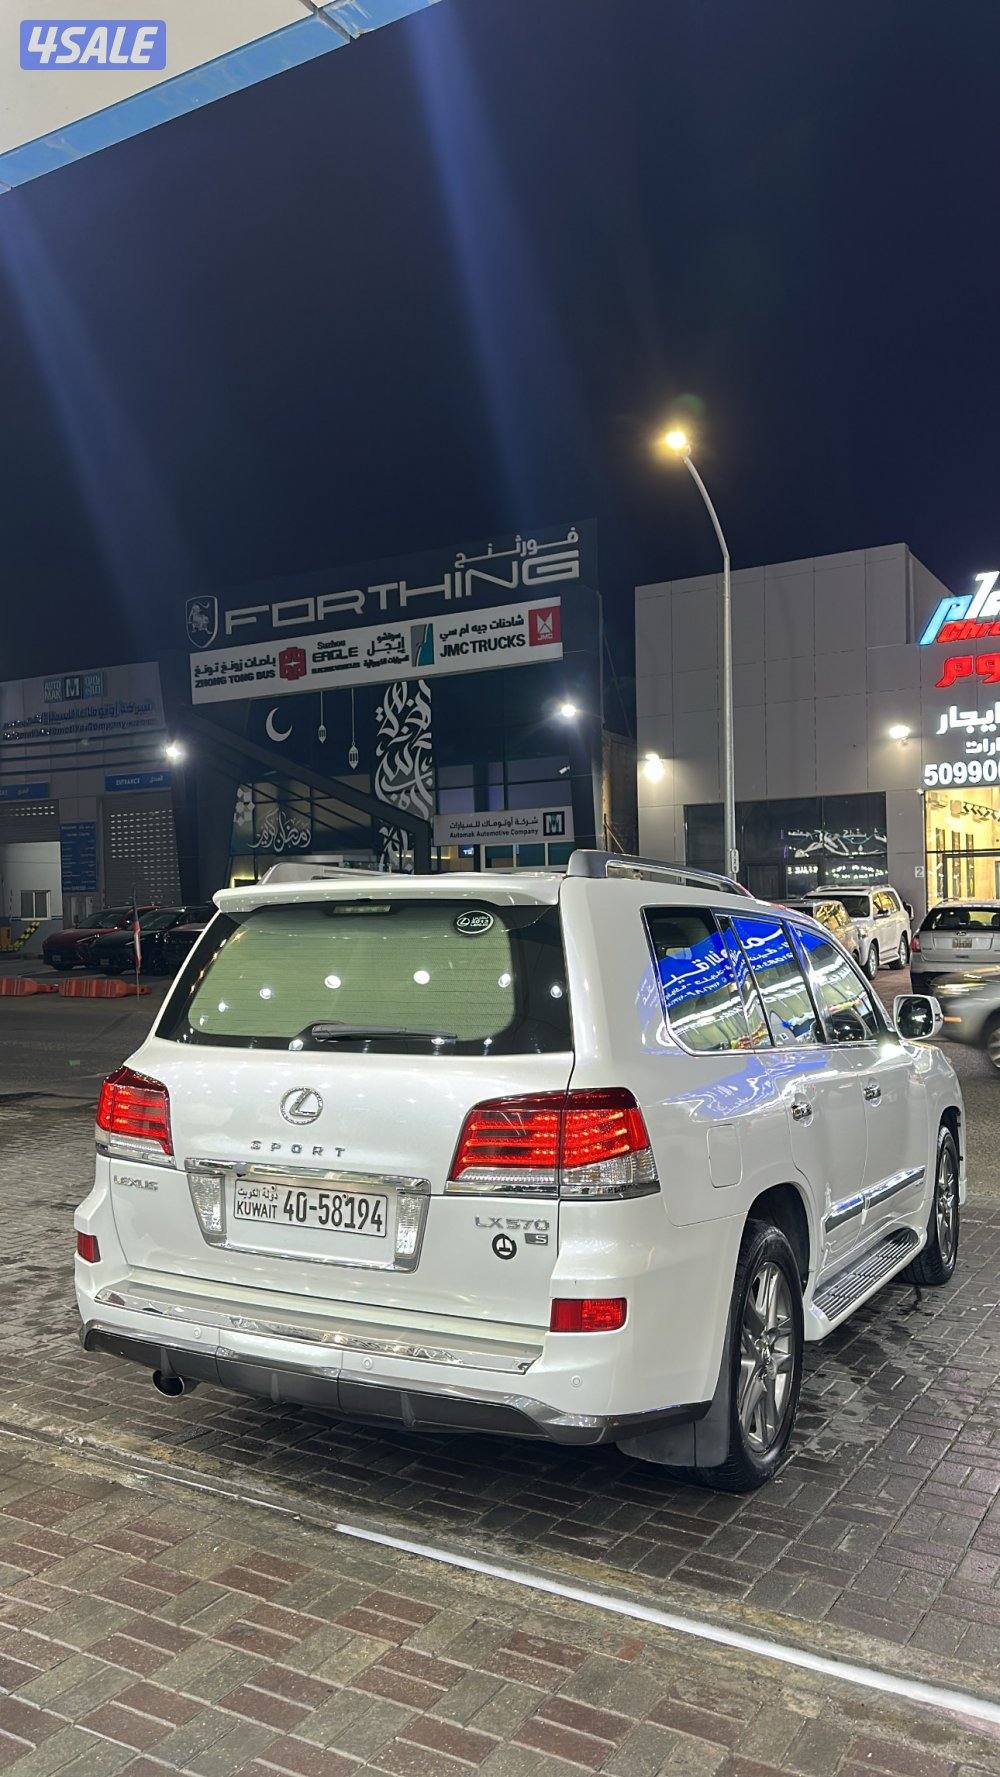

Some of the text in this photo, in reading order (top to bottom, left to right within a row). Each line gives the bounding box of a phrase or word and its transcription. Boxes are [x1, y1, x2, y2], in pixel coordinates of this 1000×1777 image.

[225, 549, 579, 635] FORTHING
[311, 646, 359, 662] EAGLE
[255, 669, 275, 680] BUS
[924, 759, 1000, 786] 50990
[476, 828, 510, 837] Automotive
[510, 826, 538, 837] Company
[250, 1139, 346, 1158] SPORT
[113, 1174, 159, 1191] LEXUS
[236, 1200, 278, 1219] KUWAIT
[283, 1189, 383, 1232] 40-58194
